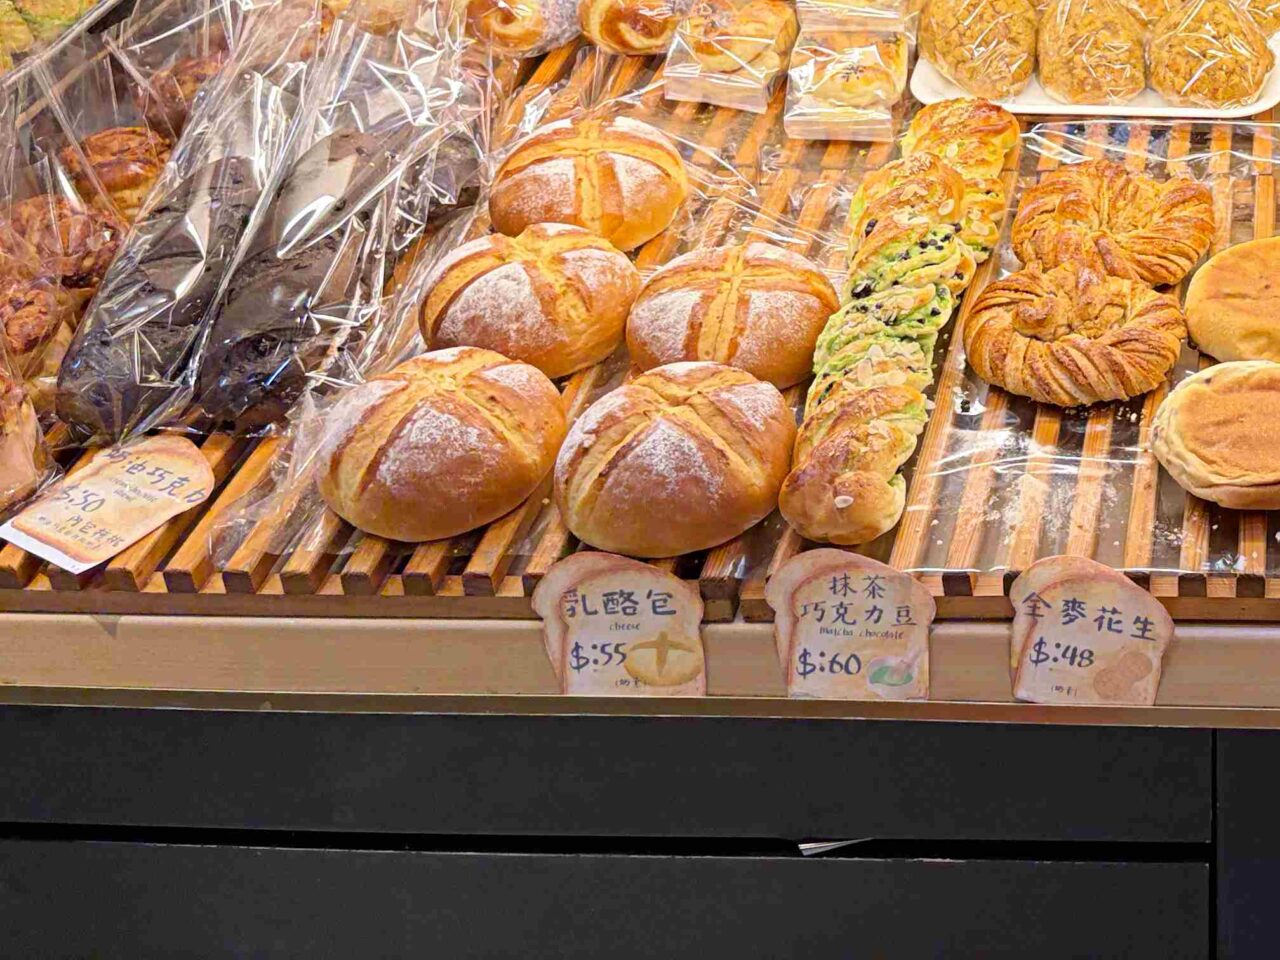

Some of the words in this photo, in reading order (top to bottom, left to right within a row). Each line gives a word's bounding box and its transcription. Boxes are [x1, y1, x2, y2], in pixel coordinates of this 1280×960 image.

[828, 572, 887, 599] 抹茶
[563, 589, 677, 618] 乳酪包
[800, 600, 918, 627] 巧克力豆
[1022, 592, 1157, 641] 全麥花生
